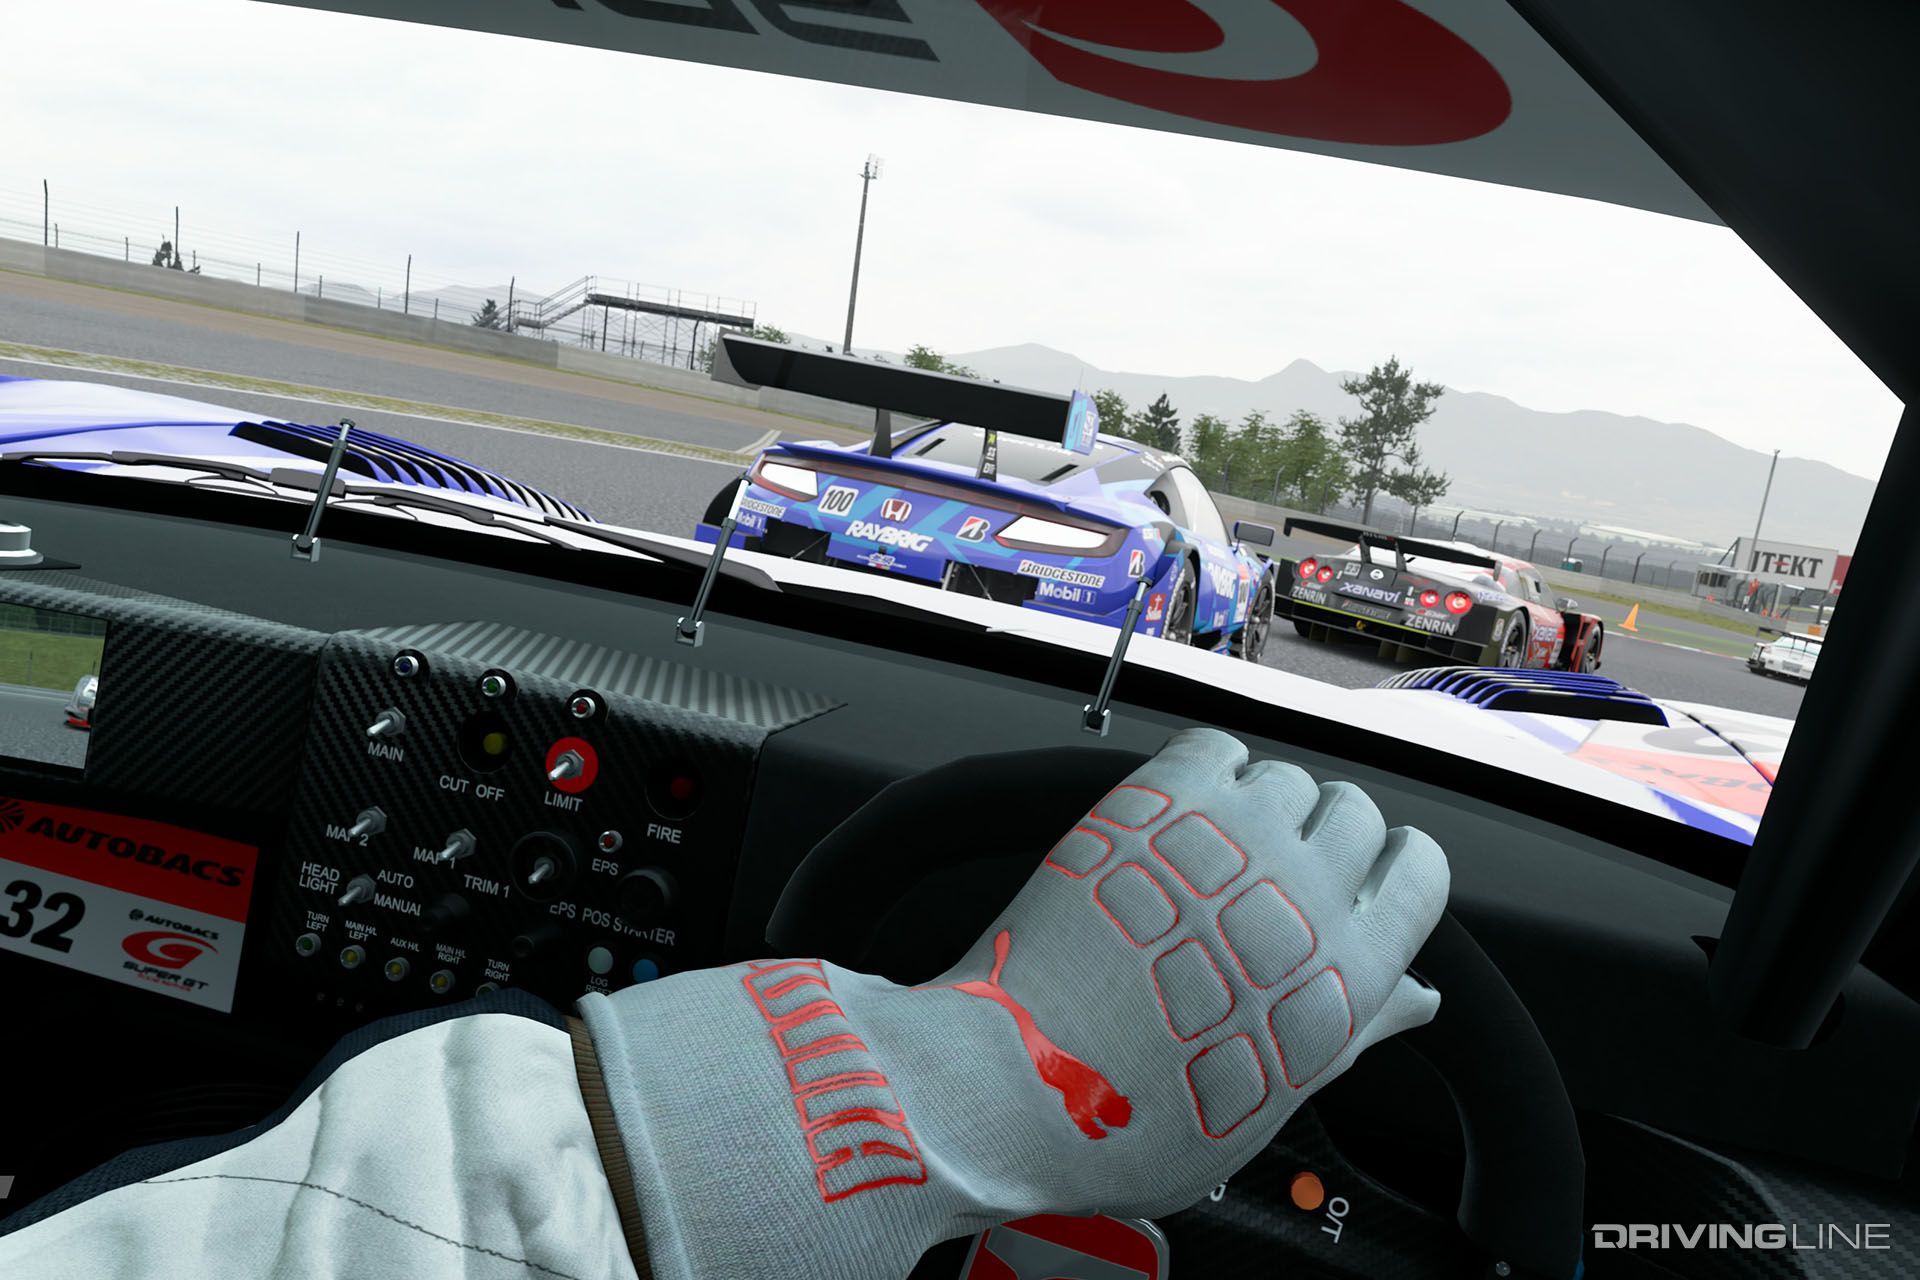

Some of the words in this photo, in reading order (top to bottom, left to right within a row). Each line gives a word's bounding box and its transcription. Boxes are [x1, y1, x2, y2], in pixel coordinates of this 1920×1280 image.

[821, 488, 855, 513] 100
[845, 520, 933, 552] RAYBRIG
[1020, 561, 1104, 587] BRIDGESTONE
[1750, 550, 1823, 579] JTEKT
[1040, 582, 1081, 602] Mobil
[1292, 585, 1327, 605] ZENRIN
[1405, 613, 1456, 636] ZENRIN
[367, 741, 404, 762] MAIN
[439, 775, 469, 793] CUT
[475, 784, 505, 802] OFF
[544, 790, 583, 812] LIMIT
[326, 824, 351, 842] MA
[359, 833, 369, 847] 2
[646, 823, 682, 844] FIRE
[26, 816, 245, 887] AUTOBACS
[301, 861, 340, 882] HEAD
[449, 856, 456, 869] 1
[592, 858, 619, 876] EPS
[299, 875, 338, 895] LIGHT
[377, 869, 414, 889] AUTO
[463, 874, 499, 896] TRIM
[503, 884, 510, 898] 1
[306, 921, 327, 932] LEFT
[307, 910, 329, 923] TURN
[582, 907, 610, 928] POS
[144, 914, 219, 941] AUTOBACS
[345, 920, 364, 932] MAIN
[365, 925, 377, 936] H/L
[349, 930, 369, 942] LEFT
[390, 937, 407, 949] AUX
[407, 941, 420, 952] H/L
[436, 943, 454, 955] MAIN
[437, 952, 461, 965] RIGHT
[487, 958, 510, 972] TURN
[123, 961, 181, 983] SUPER
[182, 977, 209, 990] GT
[484, 968, 510, 982] RIGHT
[590, 976, 608, 988] LOG
